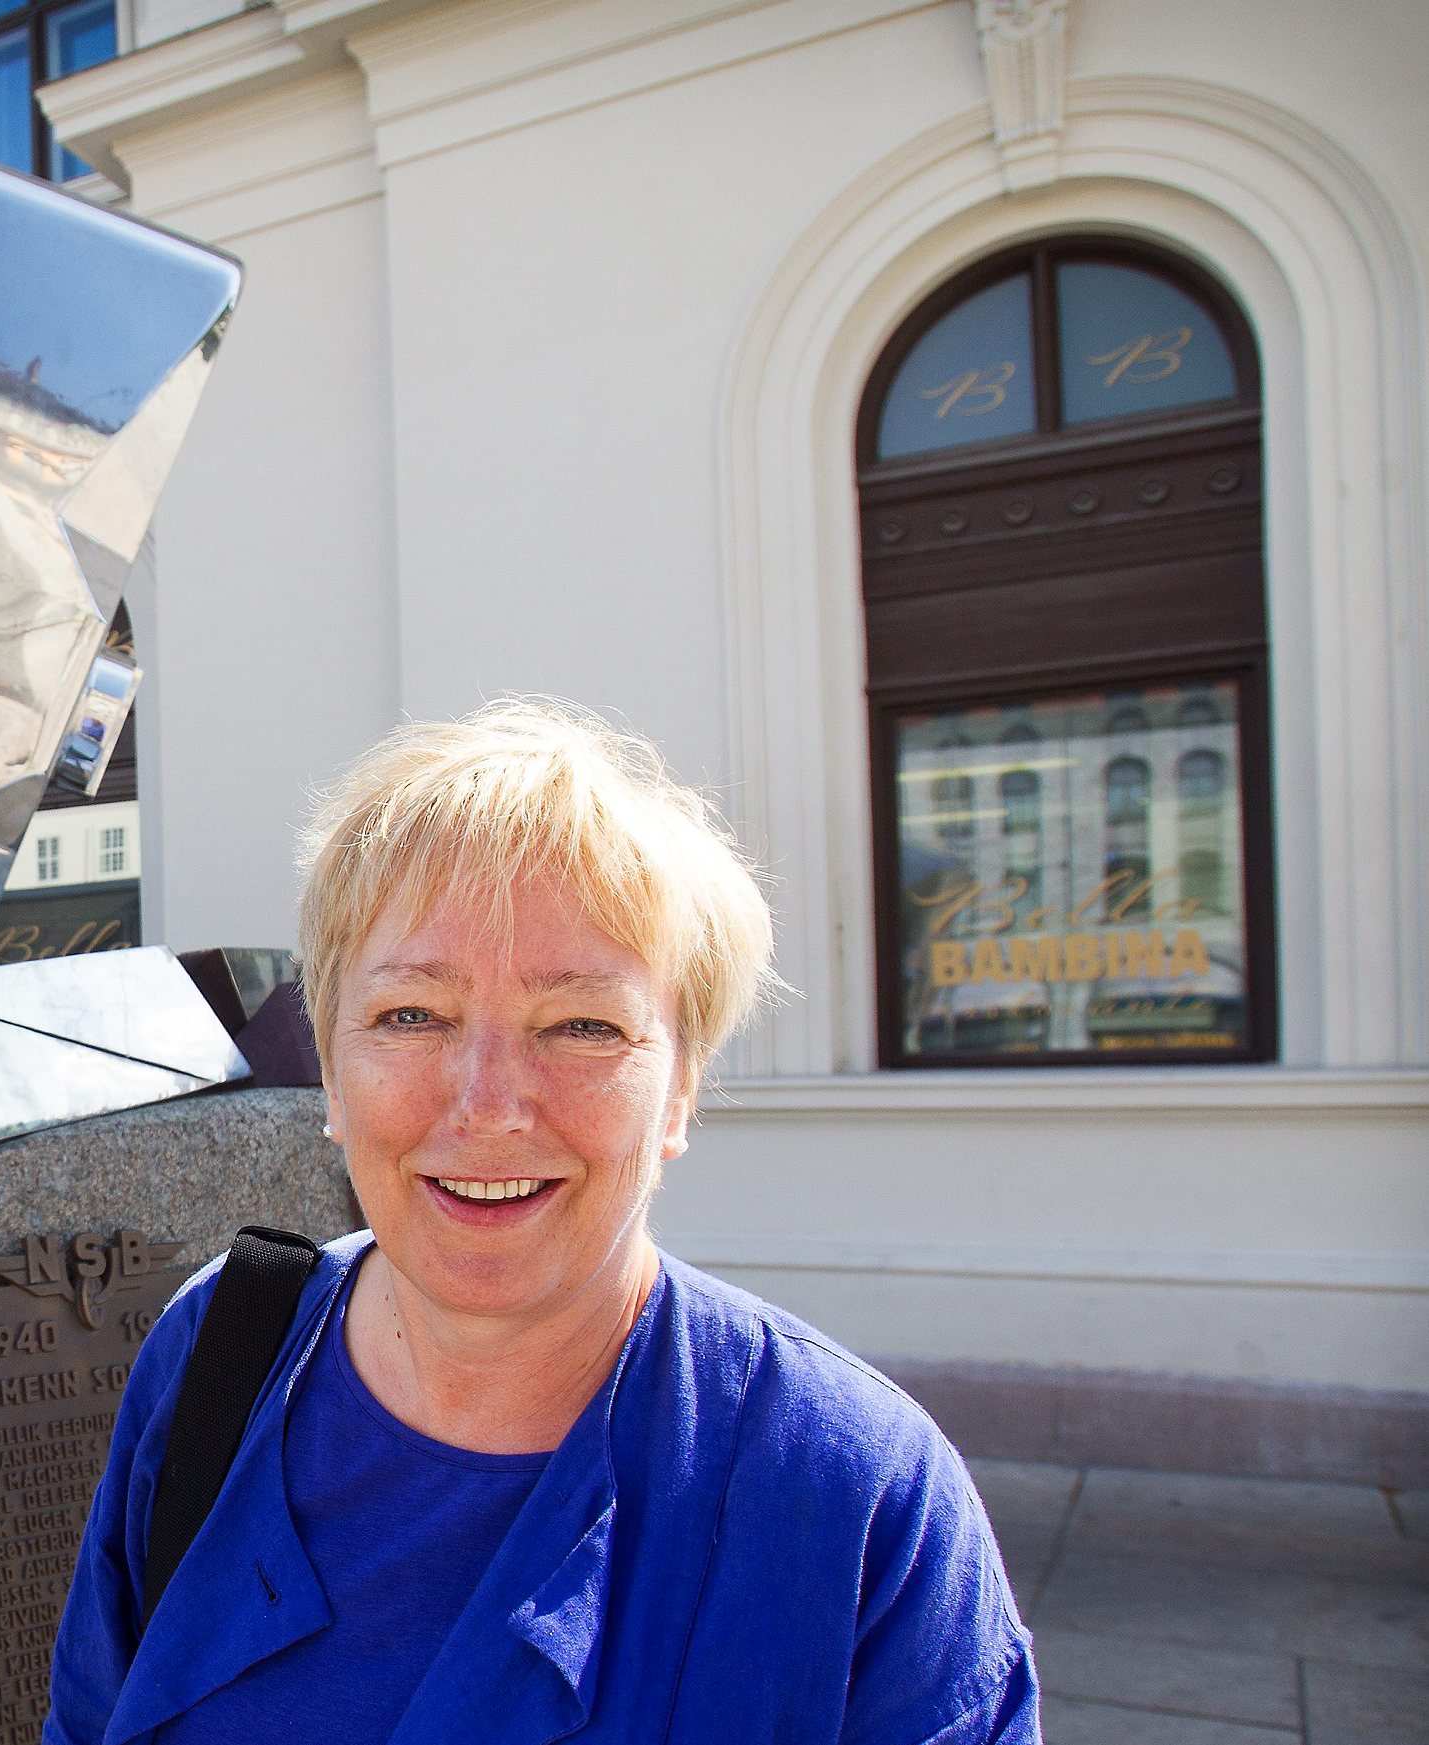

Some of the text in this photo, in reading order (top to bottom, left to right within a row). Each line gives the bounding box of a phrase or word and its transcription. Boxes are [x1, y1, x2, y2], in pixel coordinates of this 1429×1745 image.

[930, 928, 1212, 988] BAMBINA
[23, 1228, 153, 1285] NSB
[92, 1364, 130, 1394] SO
[48, 1412, 116, 1439] FERDIN
[14, 1508, 74, 1534] EUGEN
[19, 1624, 59, 1649] KNU
